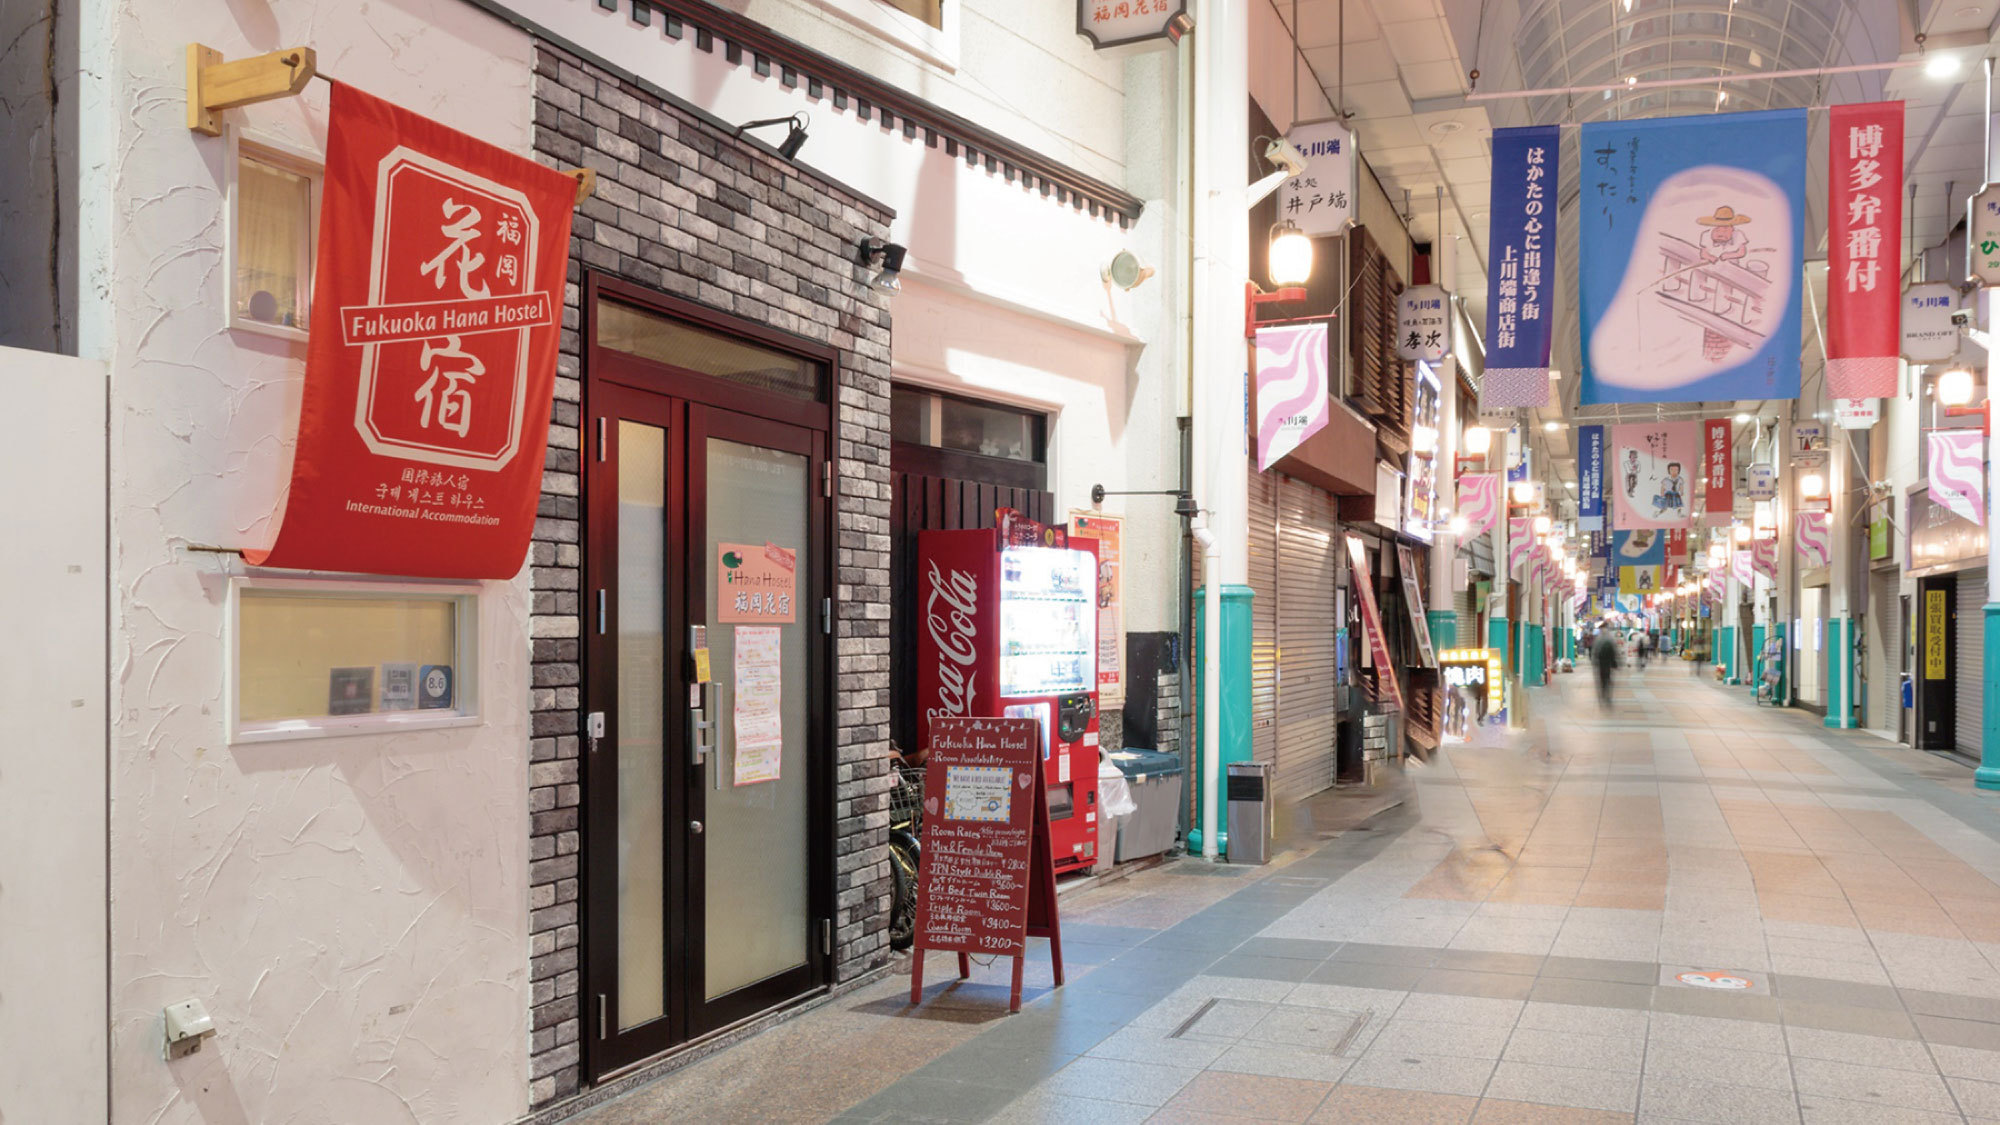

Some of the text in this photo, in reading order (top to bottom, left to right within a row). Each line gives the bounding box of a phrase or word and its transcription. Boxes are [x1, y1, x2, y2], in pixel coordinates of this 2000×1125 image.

[1286, 190, 1347, 214] 井戸端
[1845, 125, 1884, 293] 博多弁番付
[496, 212, 521, 286] 福岡
[1498, 245, 1517, 349] 上川端商店街
[352, 300, 543, 337] Fukuoka Hana Hostel
[1404, 330, 1441, 349] 孝次
[375, 483, 485, 509] 국제 게스트 하우스
[346, 500, 500, 526] International Accommodation
[735, 590, 790, 615] 福岡花宿
[926, 557, 978, 717] ca-Cola
[428, 677, 446, 689] 8.6
[932, 735, 1027, 750] Fukuoka Hana Hostel
[935, 751, 959, 763] Room
[931, 825, 955, 837] Room
[931, 863, 949, 874] JPN
[948, 885, 965, 895] Bed
[990, 889, 1010, 899] Room
[929, 902, 981, 916] Triple Room
[951, 923, 972, 933] Room
